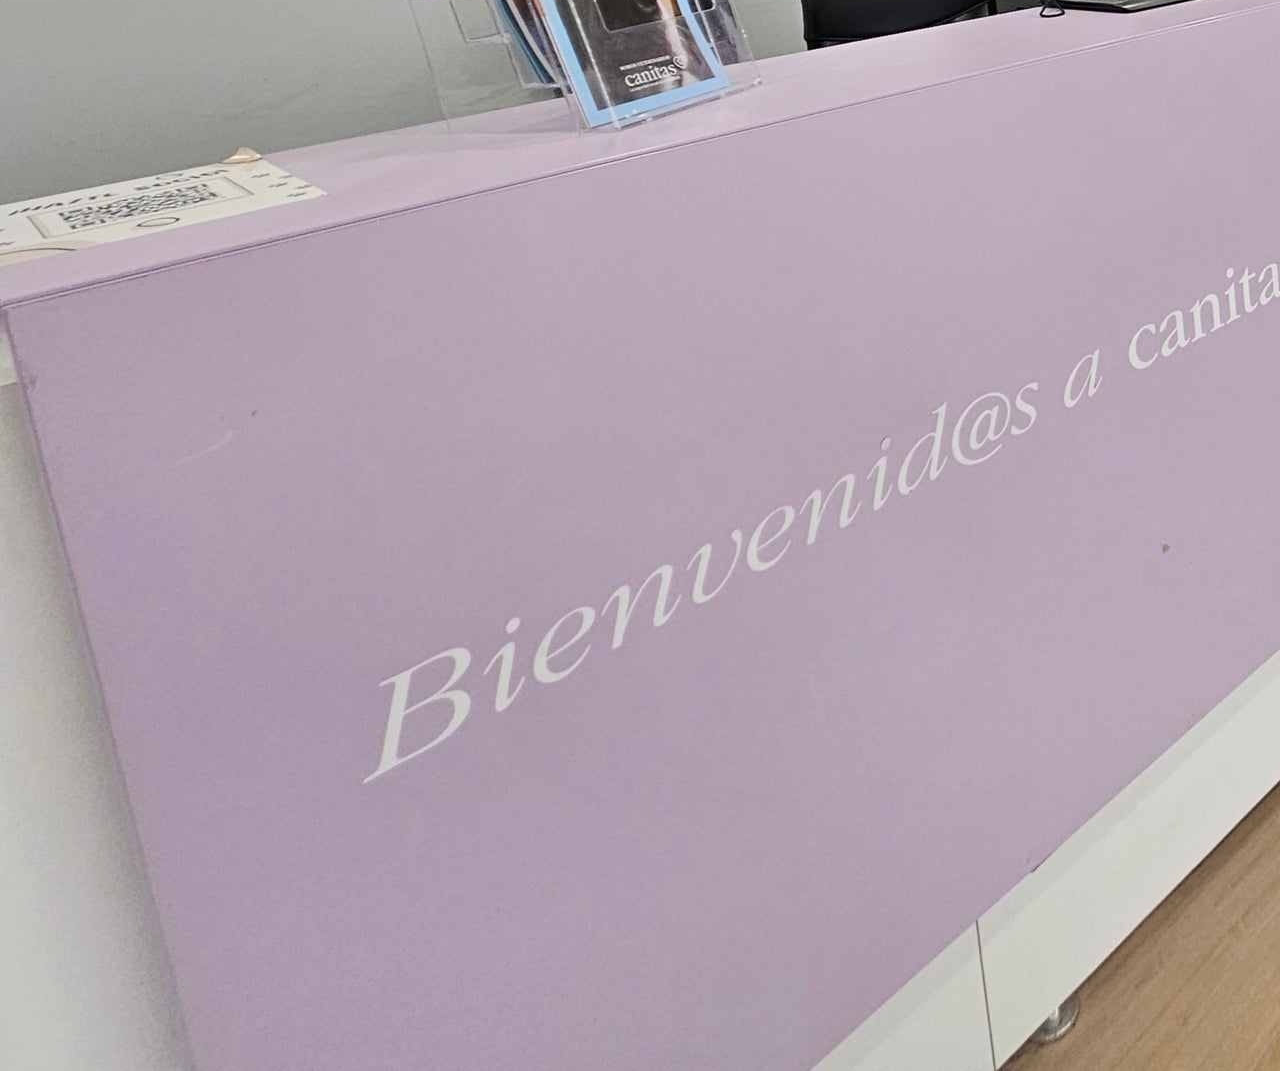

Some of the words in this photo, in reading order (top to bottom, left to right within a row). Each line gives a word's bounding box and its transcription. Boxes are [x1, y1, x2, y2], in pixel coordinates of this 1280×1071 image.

[624, 63, 678, 87] canitas
[363, 379, 1040, 783] Bienvenid@s
[1063, 349, 1103, 411] a
